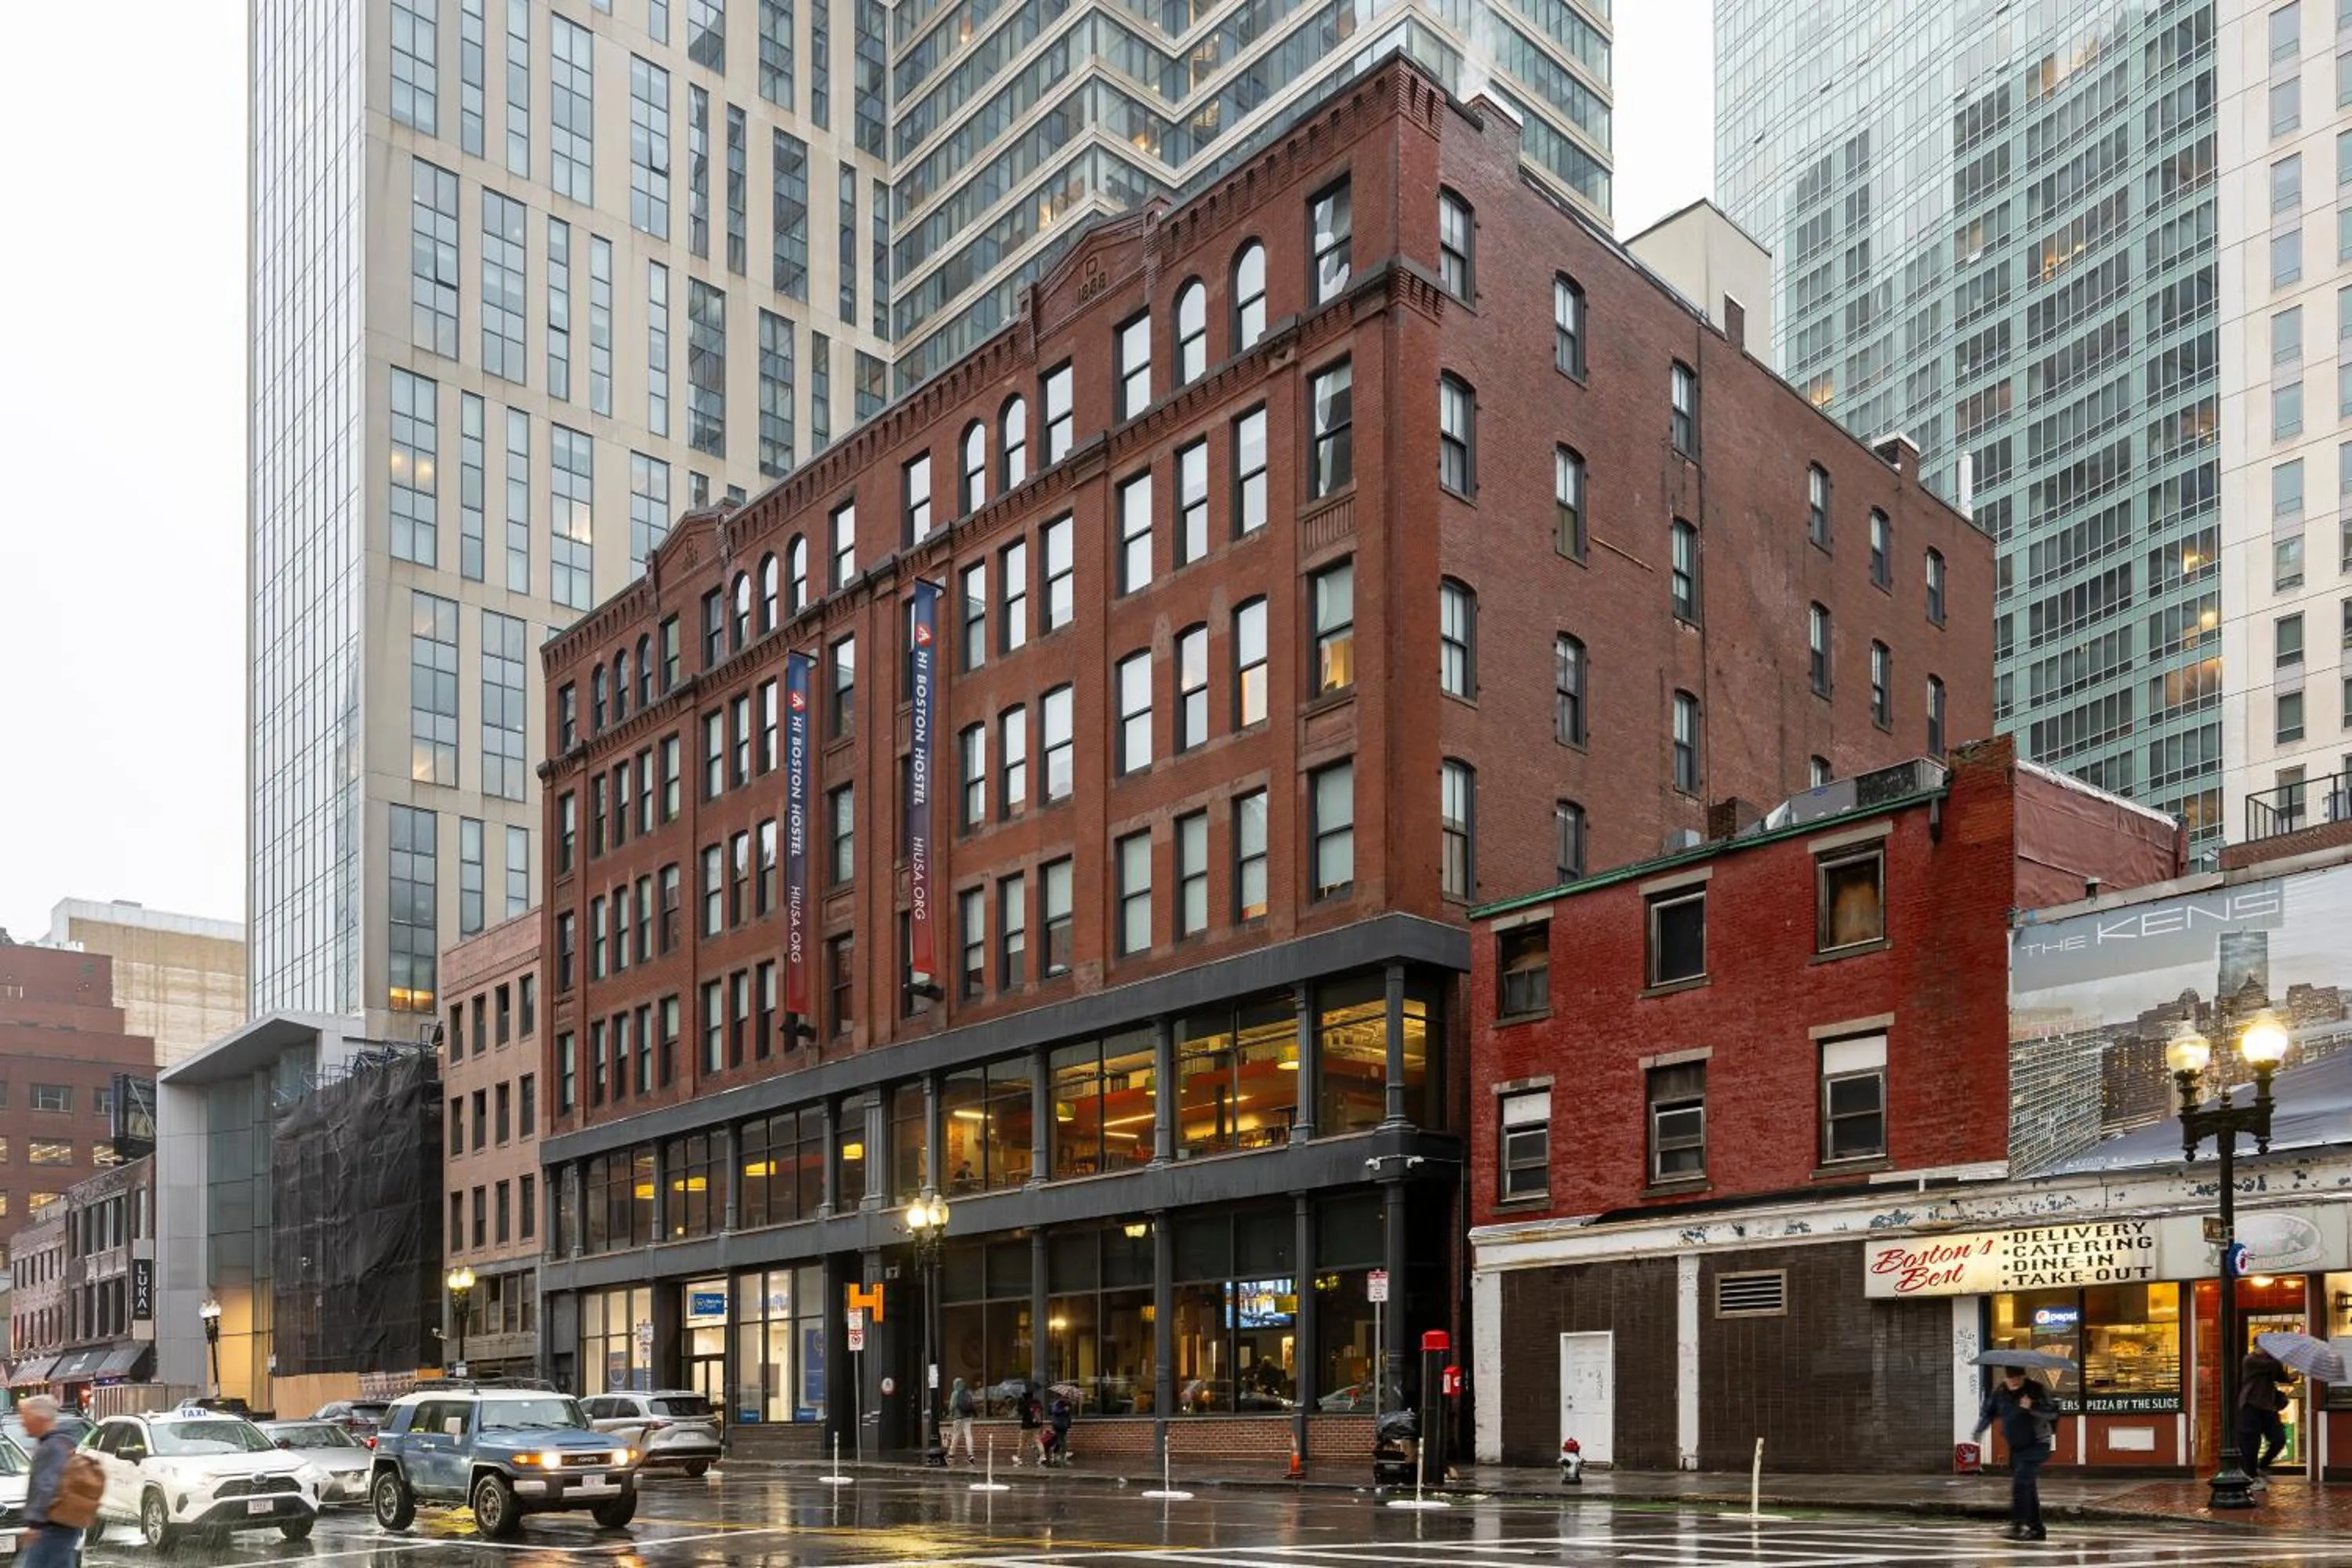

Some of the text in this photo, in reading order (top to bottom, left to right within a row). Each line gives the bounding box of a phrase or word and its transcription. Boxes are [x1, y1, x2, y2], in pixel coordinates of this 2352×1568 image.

[913, 650, 927, 806] HI BOSTON HOSTEL
[790, 716, 803, 857] HI BOSTON HOSTEL
[913, 836, 926, 920] HIUSA.ORG
[789, 885, 801, 964] HIUSA.ORG
[2021, 889, 2279, 957] THE KENS
[2013, 1221, 2147, 1243] DELIVERY
[1871, 1236, 1994, 1273] Boston's
[2013, 1236, 2153, 1258] CATERING
[2013, 1254, 2114, 1272] DINE-IN
[1894, 1264, 1965, 1292] Best
[2012, 1266, 2153, 1287] TAKE-OUT
[2050, 1311, 2078, 1323] pepsi
[182, 1408, 208, 1418] TAXI
[2059, 1398, 2180, 1410] ERS PIZZA BY THE SLICE
